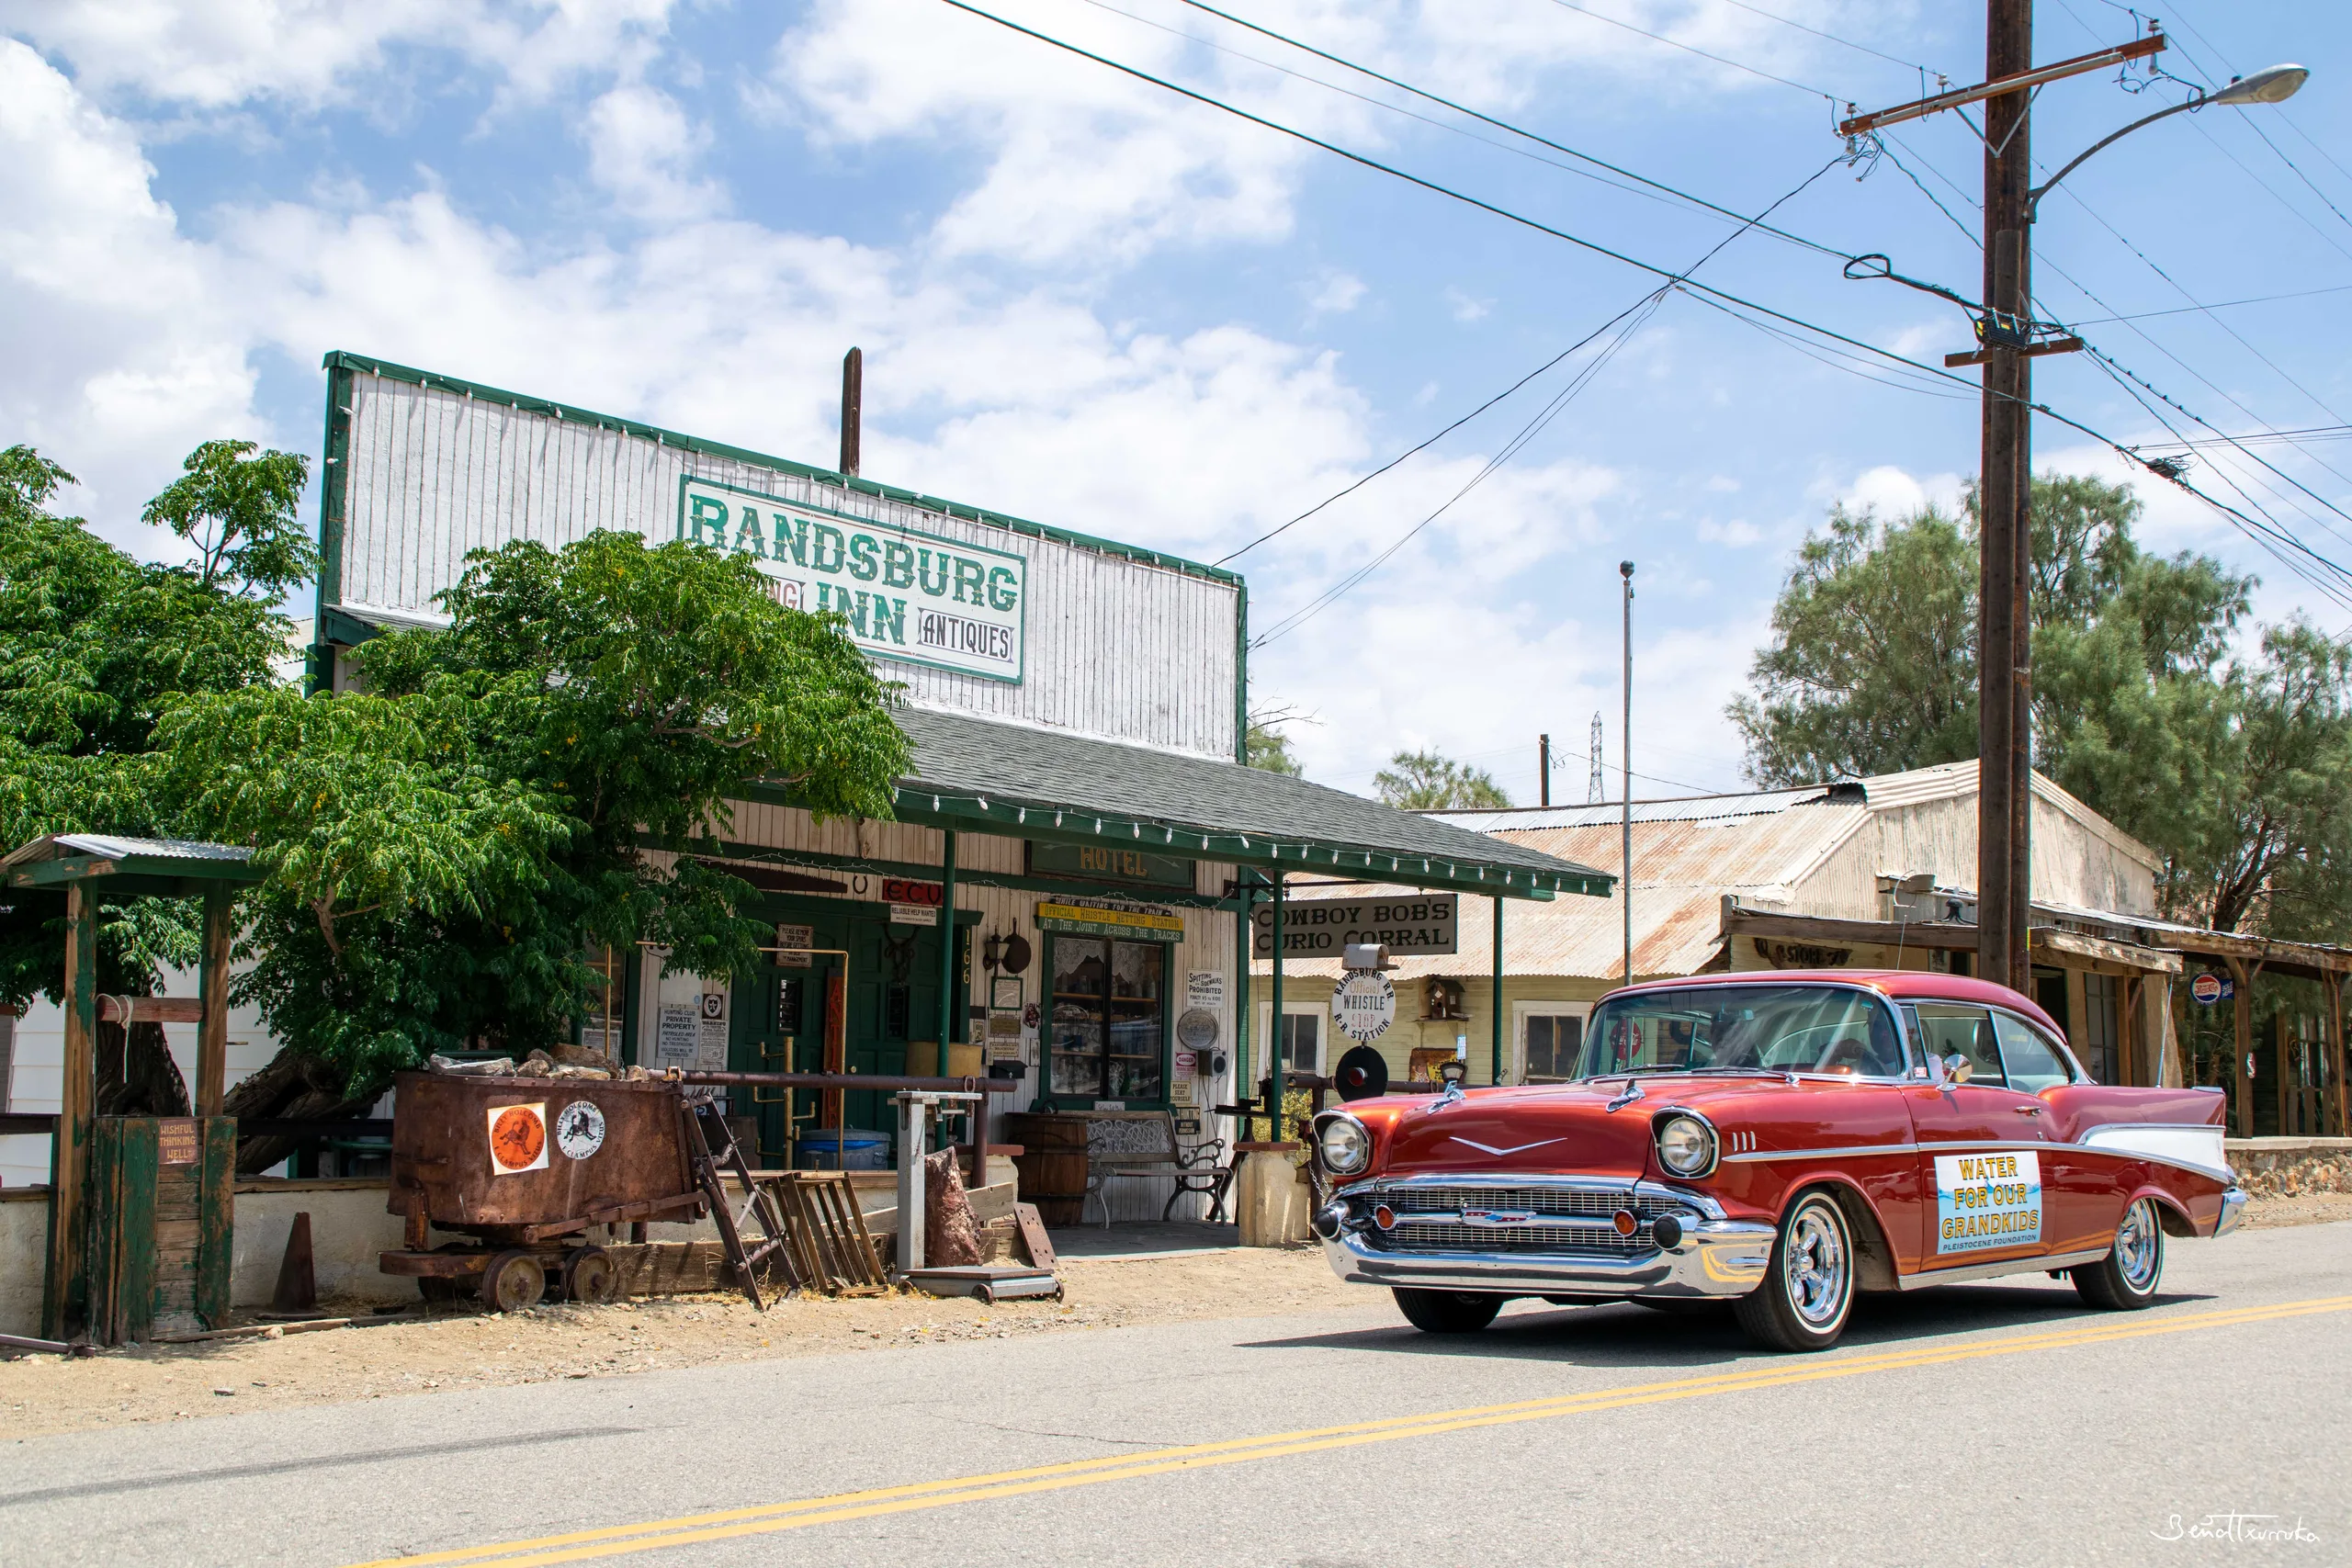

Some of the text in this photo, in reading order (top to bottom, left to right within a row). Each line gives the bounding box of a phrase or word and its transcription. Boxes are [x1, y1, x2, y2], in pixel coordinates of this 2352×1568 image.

[690, 493, 1018, 612] RANDSBURG
[817, 581, 908, 646] INN
[923, 613, 1010, 660] ANTIQUES
[1080, 846, 1148, 877] HOTEL
[1055, 897, 1076, 906] WHILE
[1080, 900, 1109, 909] WAITING
[1374, 898, 1450, 923] BOB'S
[1043, 918, 1181, 941] AT THE JOINT ACROSS THE TRACKS
[1343, 928, 1450, 948] CORRAL
[963, 929, 971, 984] 166
[1189, 973, 1211, 983] SPITTING
[1201, 977, 1222, 987] SIDEWALKS
[1334, 967, 1383, 996] RANDSBURG
[1189, 985, 1222, 995] PROHIBITED
[1343, 995, 1385, 1010] WHISTLE
[1351, 1013, 1374, 1028] STOP
[1351, 1018, 1390, 1041] STATION
[161, 1124, 194, 1134] WISHFUL
[494, 1110, 540, 1133] BILLY HOLCOMB
[557, 1116, 565, 1135] BILLY
[159, 1136, 196, 1146] THINKING
[167, 1149, 187, 1159] WELL
[1958, 1156, 2018, 1180] WATER
[1954, 1183, 2028, 1210] FOR OUR
[1941, 1209, 2039, 1240] GRANDKIDS
[1943, 1235, 2037, 1251] PLEISTOCENE FOUNDATION
